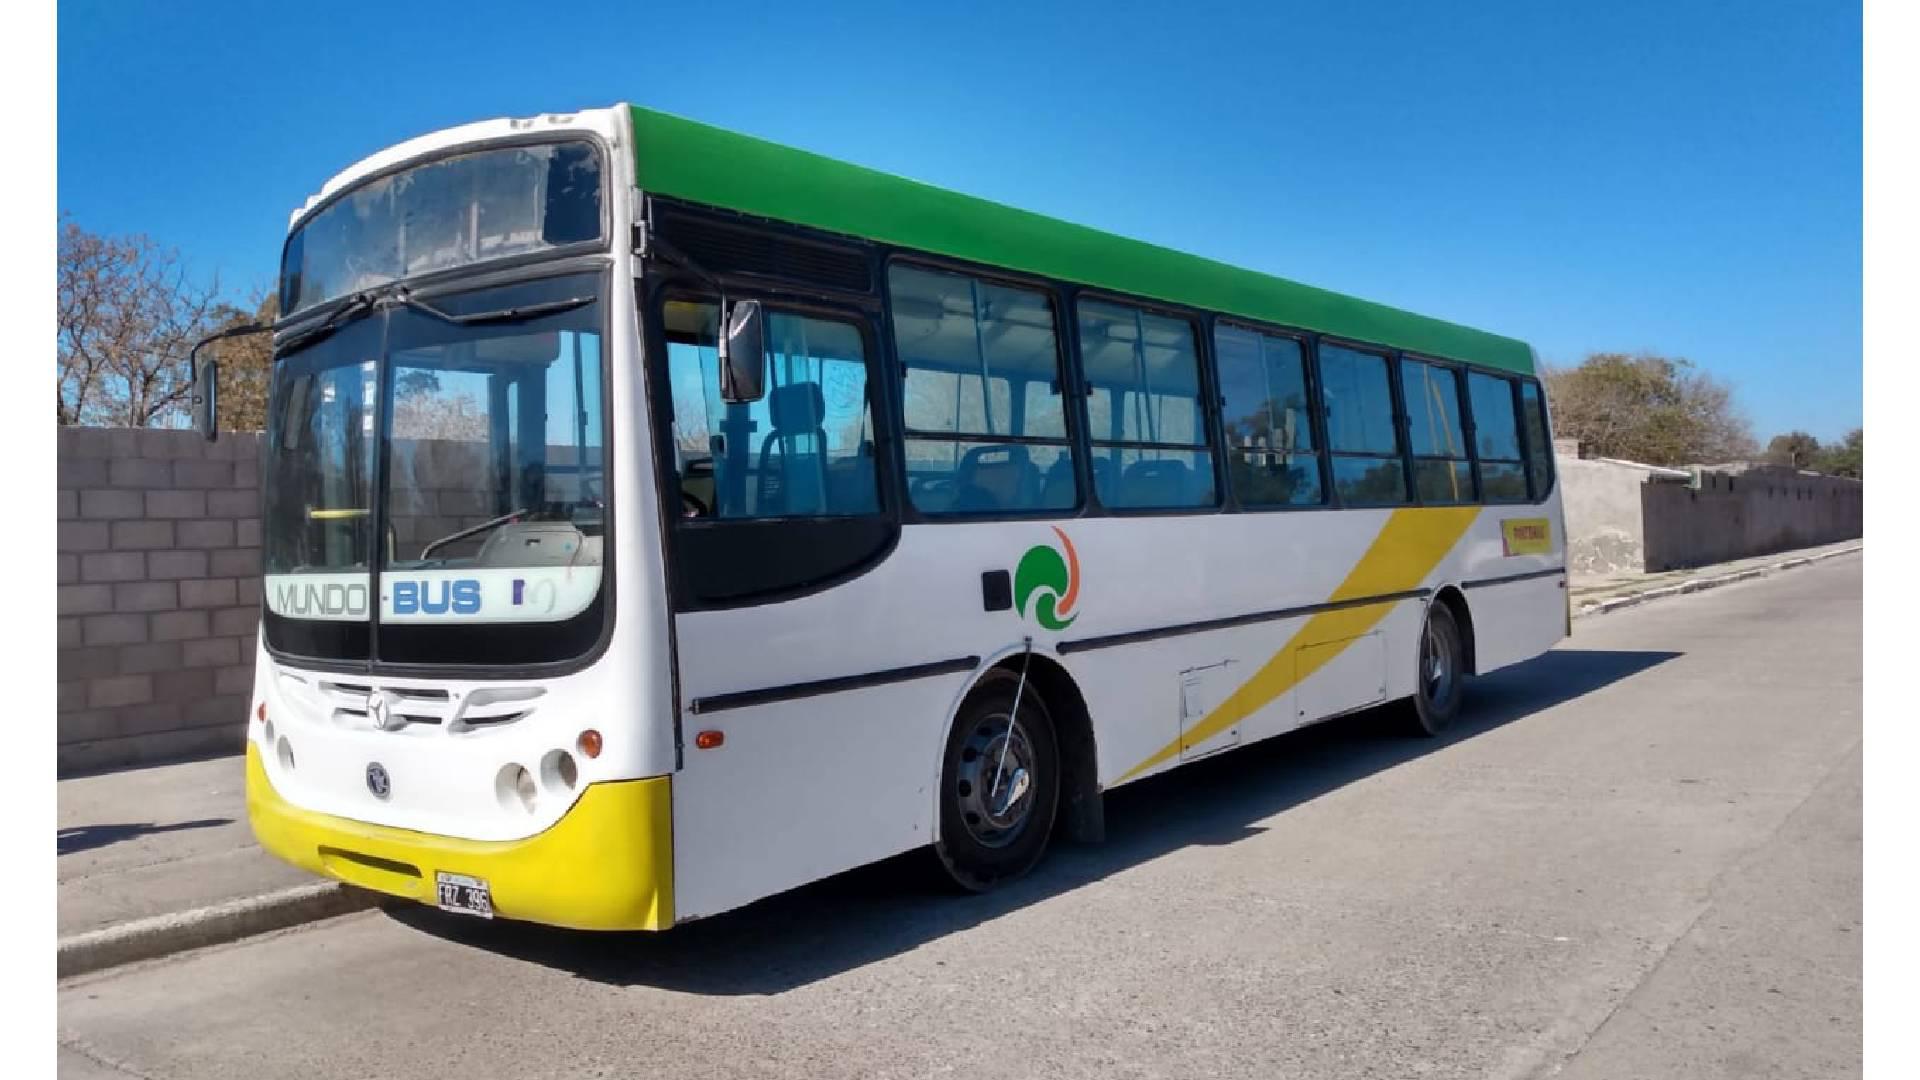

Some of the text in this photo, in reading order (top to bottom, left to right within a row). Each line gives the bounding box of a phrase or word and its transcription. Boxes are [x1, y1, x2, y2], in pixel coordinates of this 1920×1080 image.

[277, 583, 367, 615] MUNDO
[393, 580, 482, 615] BUS
[438, 884, 488, 912] FRZ 396
